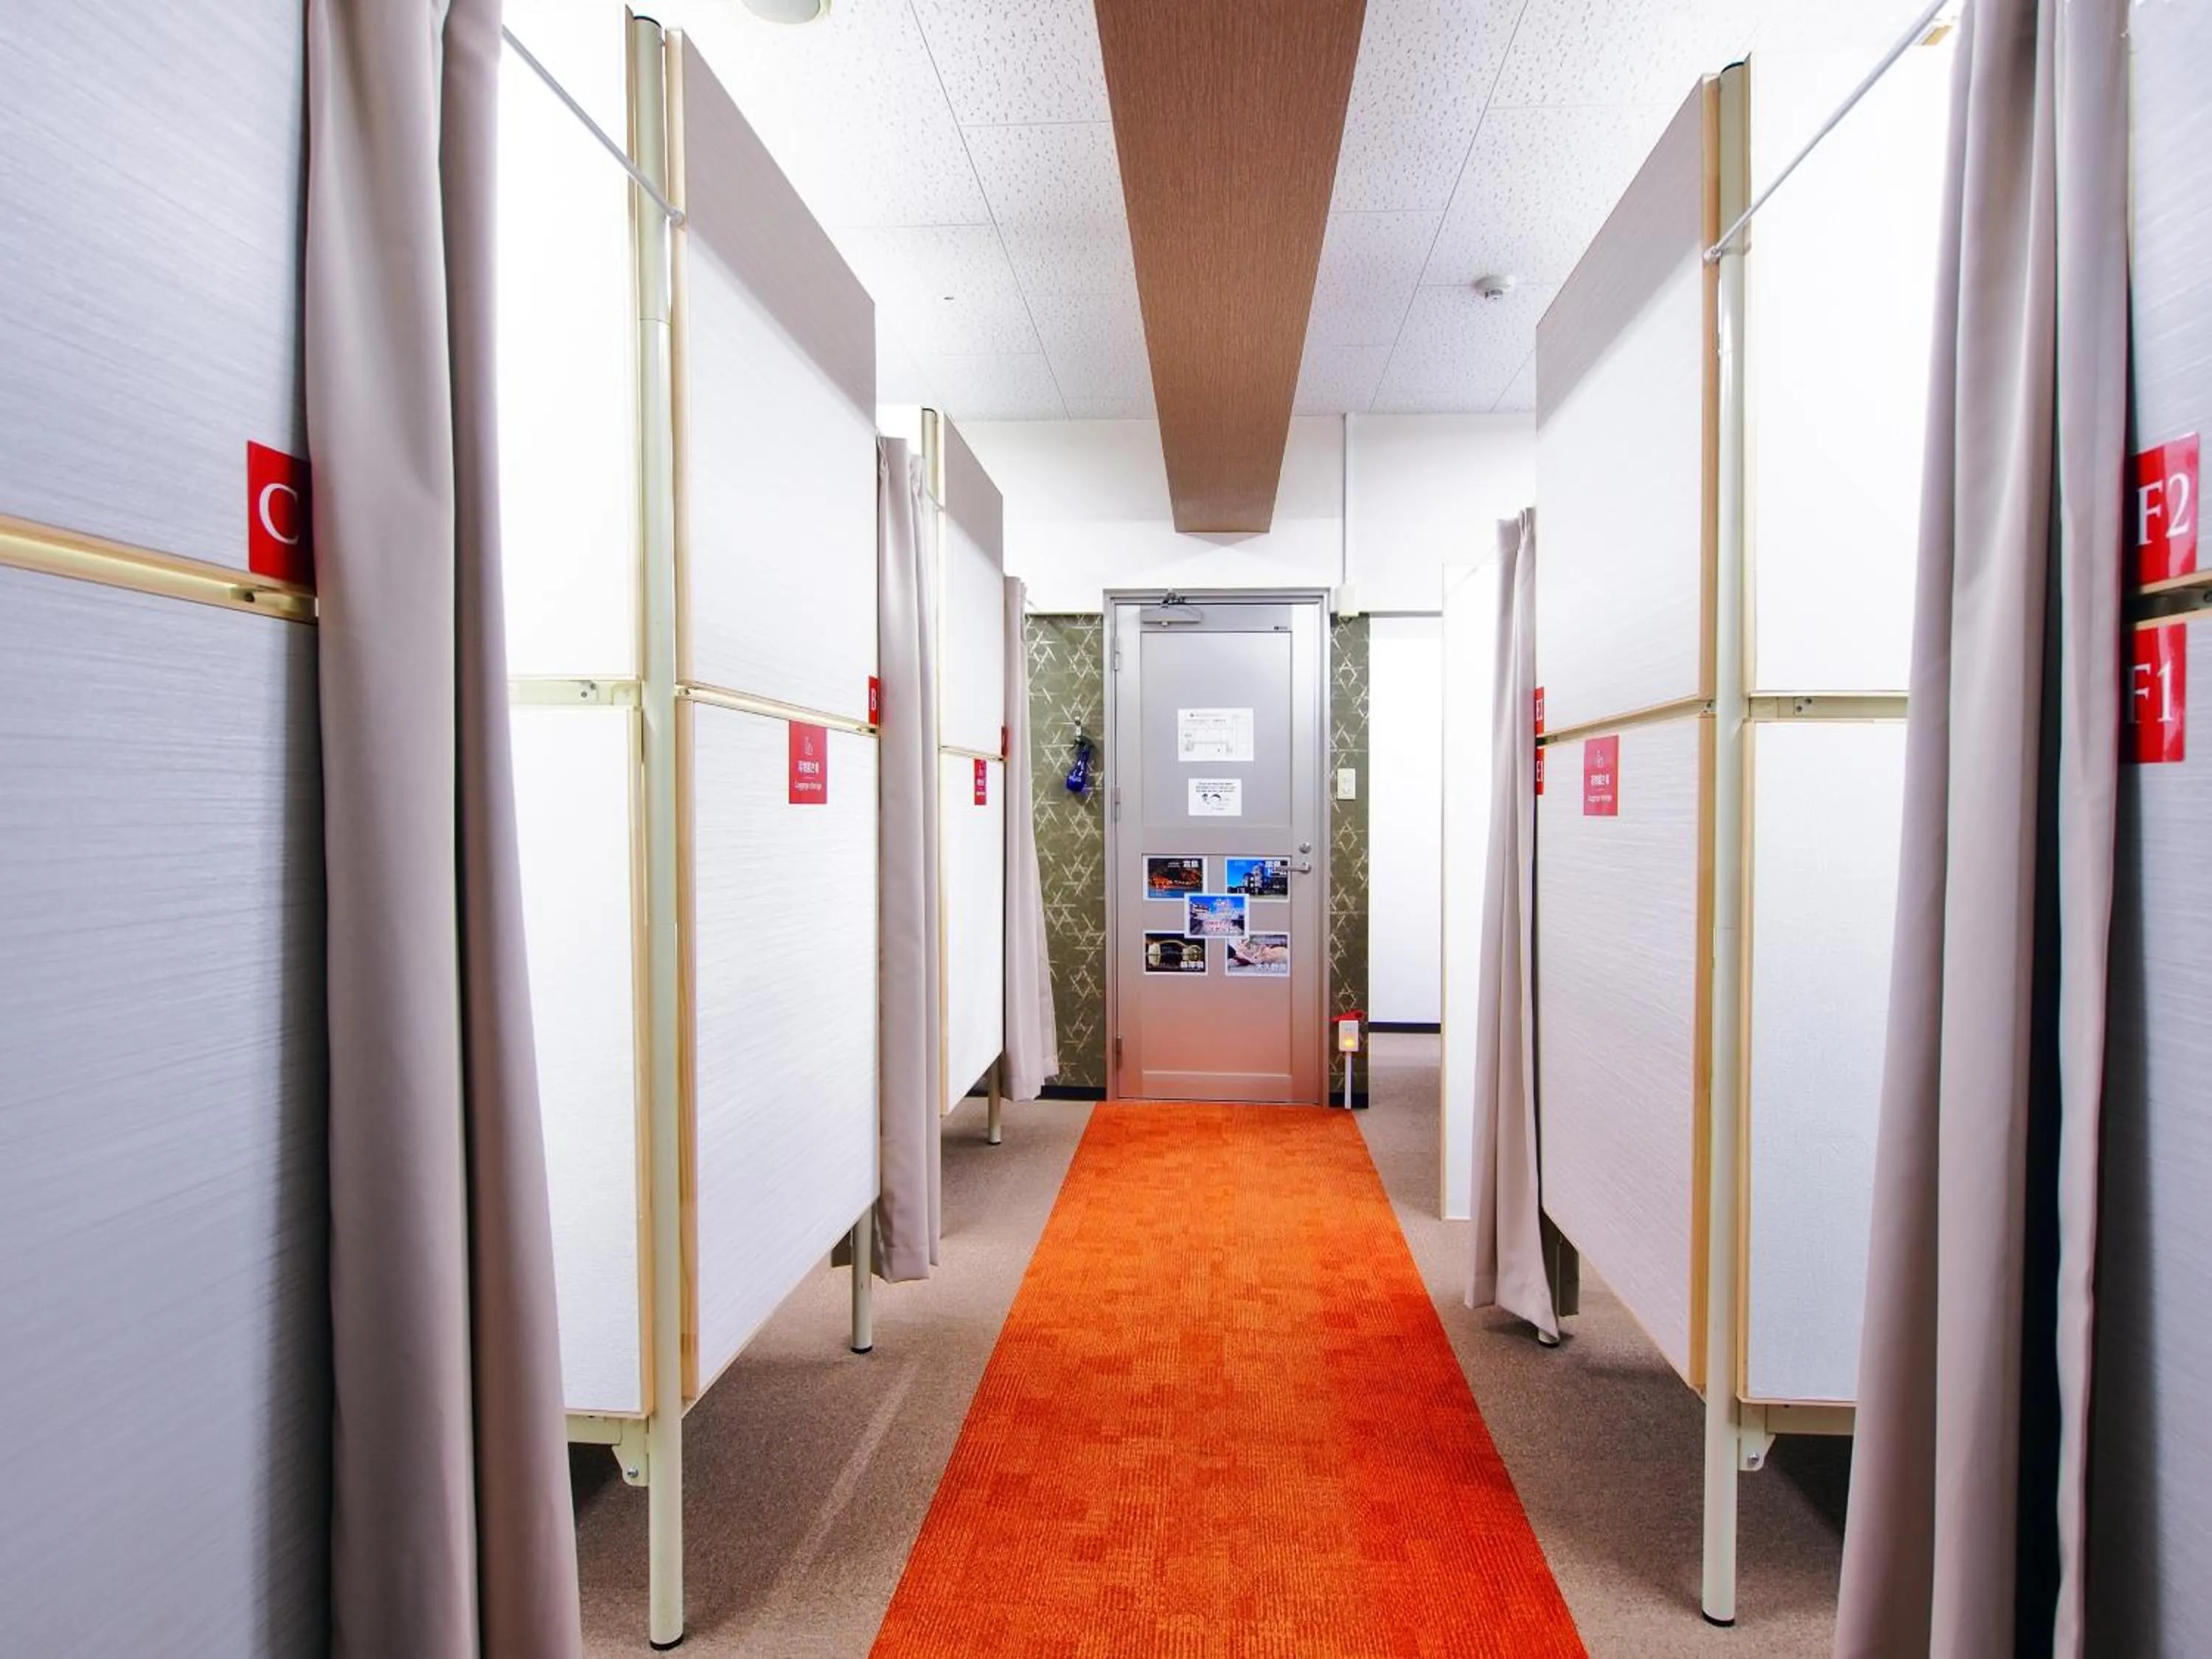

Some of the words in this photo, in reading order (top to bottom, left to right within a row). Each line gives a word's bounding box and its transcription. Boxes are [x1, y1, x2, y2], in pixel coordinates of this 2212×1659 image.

[259, 482, 299, 546] C
[2135, 471, 2190, 548] F2
[870, 687, 877, 711] B
[2126, 659, 2173, 724] F1
